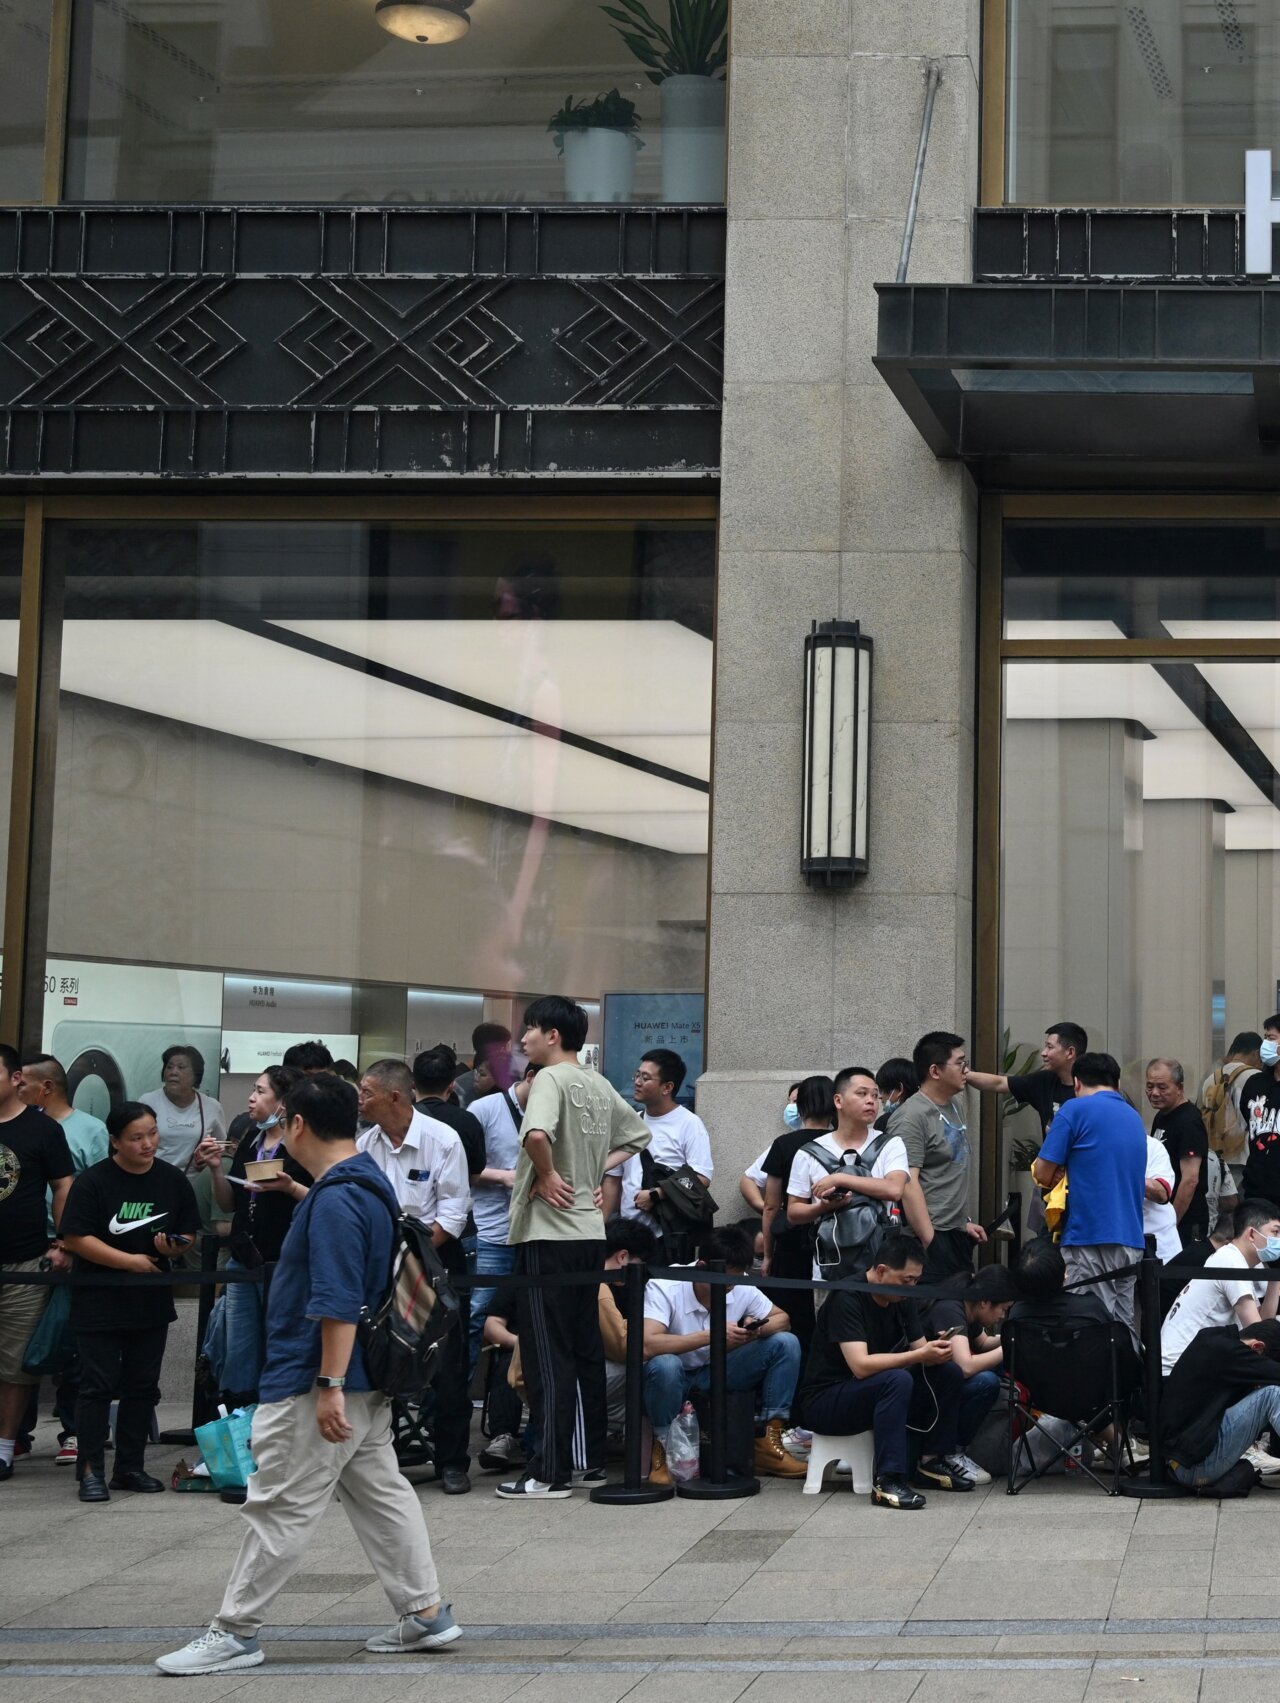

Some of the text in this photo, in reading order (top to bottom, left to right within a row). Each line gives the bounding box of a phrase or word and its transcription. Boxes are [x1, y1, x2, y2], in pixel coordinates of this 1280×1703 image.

[60, 977, 79, 994] 系列
[634, 1022, 669, 1030] HUAWEI
[671, 1022, 690, 1030] Mate
[644, 1035, 689, 1044] 新品上市
[118, 1201, 154, 1220] NIKE
